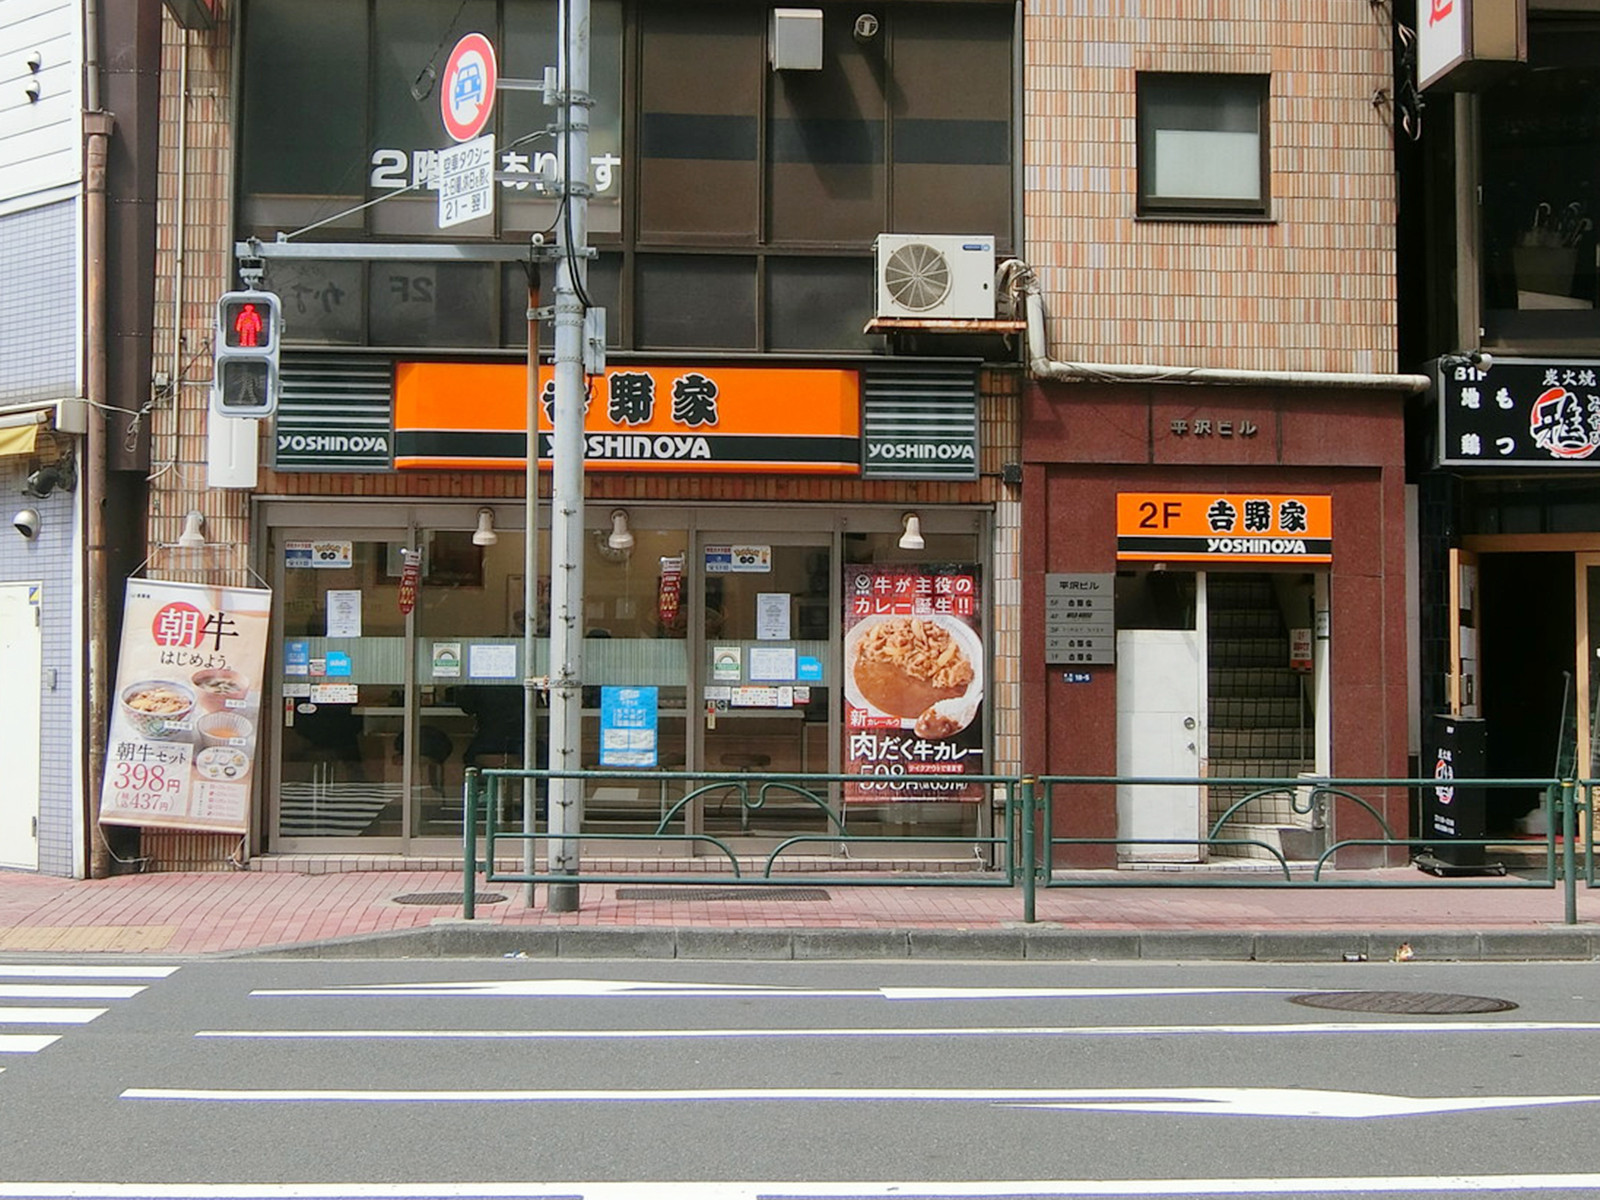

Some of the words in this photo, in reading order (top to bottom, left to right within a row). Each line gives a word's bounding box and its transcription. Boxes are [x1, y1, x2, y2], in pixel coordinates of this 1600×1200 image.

[371, 149, 621, 191] 2階ありす
[1542, 368, 1597, 387] 炭火焼
[1171, 418, 1258, 438] 平沢ビル
[278, 435, 388, 453] YOSHINOYA
[868, 442, 976, 460] YOSHINOYA
[1138, 502, 1182, 528] 2F
[1207, 499, 1308, 533] 吉野家
[1207, 538, 1307, 554] YOSHINOYA
[874, 576, 972, 594] 牛が主役の
[1059, 581, 1100, 591] 平沢ビル
[157, 608, 239, 651] 朝牛
[115, 742, 186, 765] 朝牛セット
[850, 731, 984, 761] 肉だく牛カレー
[114, 762, 181, 793] 398円
